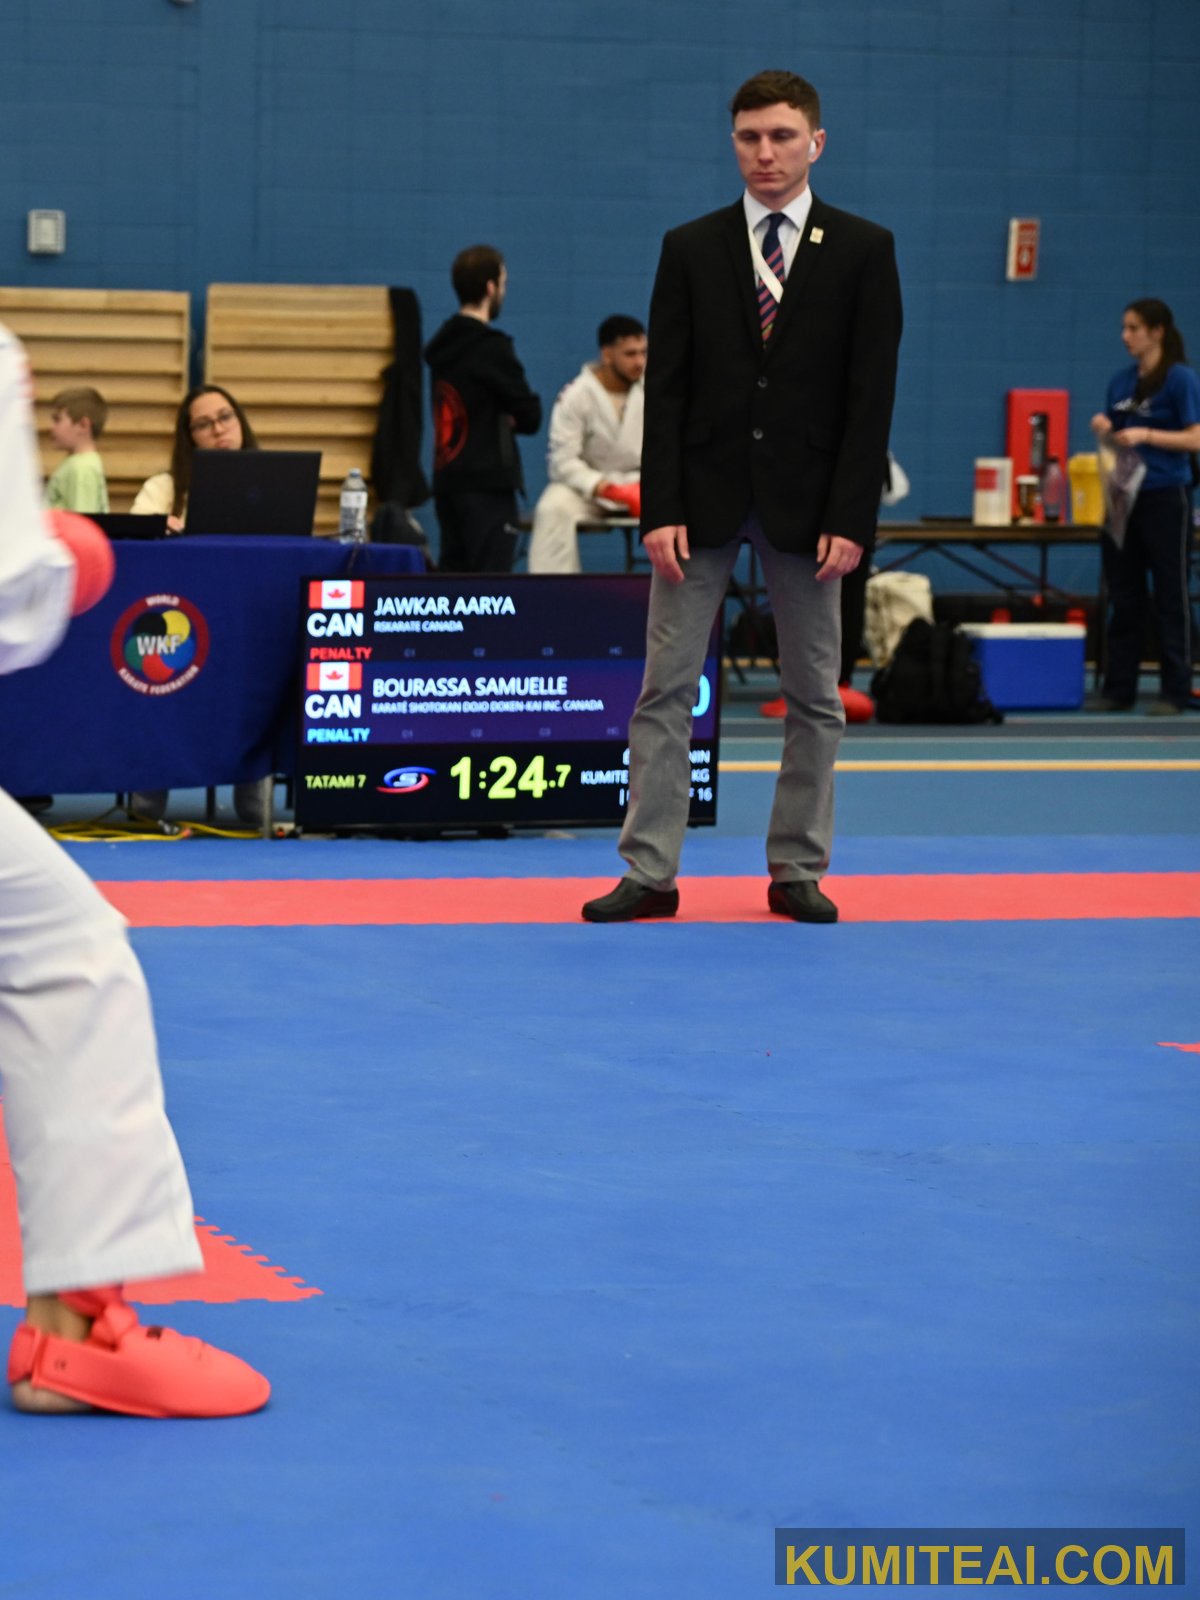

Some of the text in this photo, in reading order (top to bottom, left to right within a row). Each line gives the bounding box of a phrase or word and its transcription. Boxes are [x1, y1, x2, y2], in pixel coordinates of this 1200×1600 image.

[145, 594, 180, 608] WORLD
[373, 596, 516, 616] JAWKAR AARYA
[307, 612, 364, 637] CAN
[421, 620, 464, 632] CANADA
[137, 634, 181, 656] WKF
[309, 646, 373, 660] PENALTY
[118, 664, 199, 695] KARATE FEDERATION
[372, 676, 568, 698] BOURASSA SAMUELLE
[305, 694, 362, 719] CAN
[408, 701, 462, 714] SHOTOKAN
[462, 701, 490, 713] DOJO
[562, 699, 604, 712] CANADA
[307, 728, 371, 742] PENALTY
[305, 774, 367, 789] TATAMI 7
[580, 769, 629, 785] KUMITE
[697, 787, 713, 801] 16
